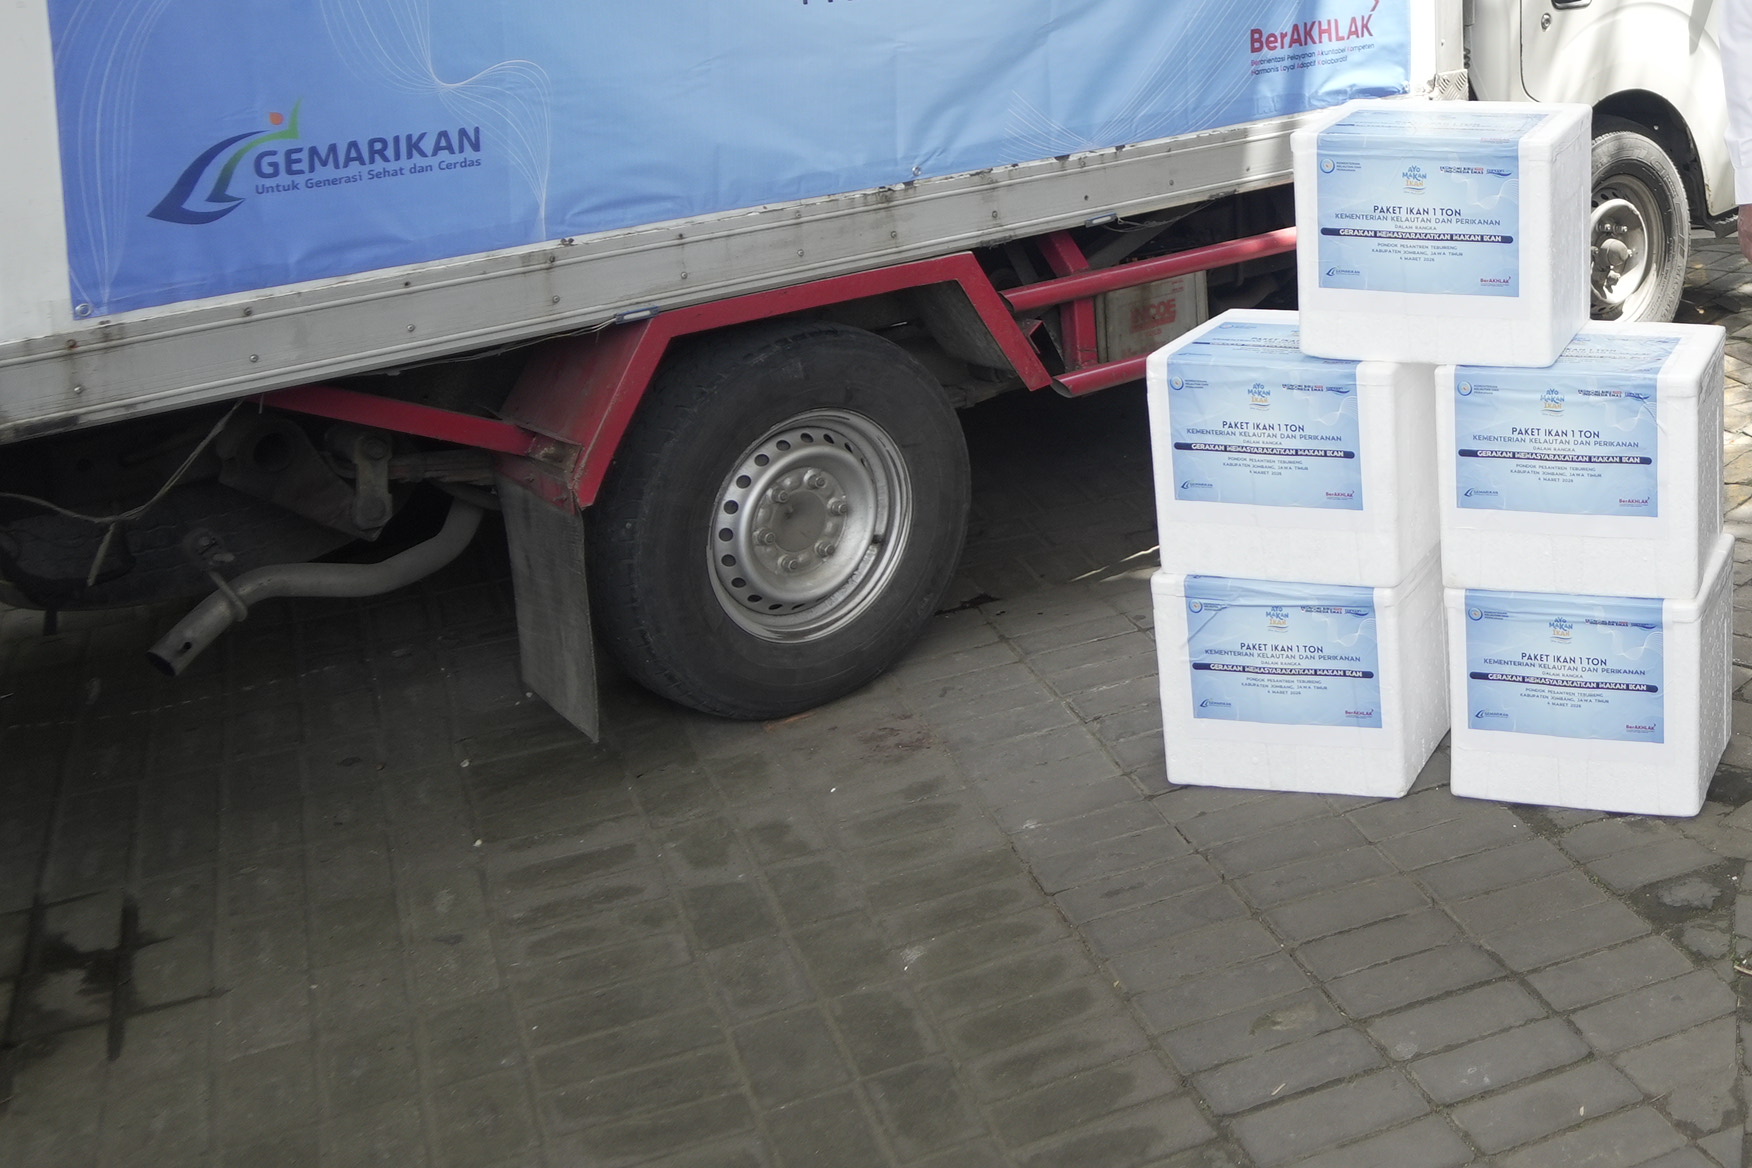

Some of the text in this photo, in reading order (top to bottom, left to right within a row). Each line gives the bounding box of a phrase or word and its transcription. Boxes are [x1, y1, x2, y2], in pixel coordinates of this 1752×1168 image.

[1250, 13, 1374, 54] BerAKHLAK
[254, 126, 482, 179] GEMARIKAN
[255, 156, 483, 195] Untuk Generasi Sehat dan Cerdas
[1373, 205, 1461, 217] PAKET IKAN 1 TON
[1335, 213, 1388, 221] KEMENTERIAN
[1456, 218, 1500, 226] PERIKANAN
[1339, 229, 1374, 237] GERAKAN
[1376, 230, 1450, 240] MEMASYARAKATKAN
[1187, 428, 1236, 436] KEMENTERIAN
[1222, 421, 1250, 429] PAKET
[1252, 423, 1275, 431] IKAN
[1285, 424, 1305, 432] TON
[1511, 427, 1541, 436] PAKET
[1544, 429, 1568, 438] IKAN
[1579, 430, 1600, 438] TON
[1191, 443, 1224, 451] GERAKAN
[1473, 435, 1526, 443] KEMENTERIAN
[1529, 437, 1570, 445] KELAUTAN
[1594, 440, 1639, 448] PERIKANAN
[1477, 450, 1513, 458] GERAKAN
[1240, 642, 1268, 651] PAKET
[1271, 644, 1293, 652] IKAN
[1302, 645, 1323, 653] TON
[1205, 649, 1254, 658] KEMENTERIAN
[1521, 652, 1550, 662] PAKET
[1553, 655, 1576, 664] IKAN
[1586, 657, 1607, 666] TON
[1210, 663, 1243, 671] GERAKAN
[1483, 658, 1535, 668] KEMENTERIAN
[1538, 664, 1578, 672] KELAUTAN
[1601, 667, 1645, 675] PERIKANAN
[1488, 673, 1523, 681] GERAKAN
